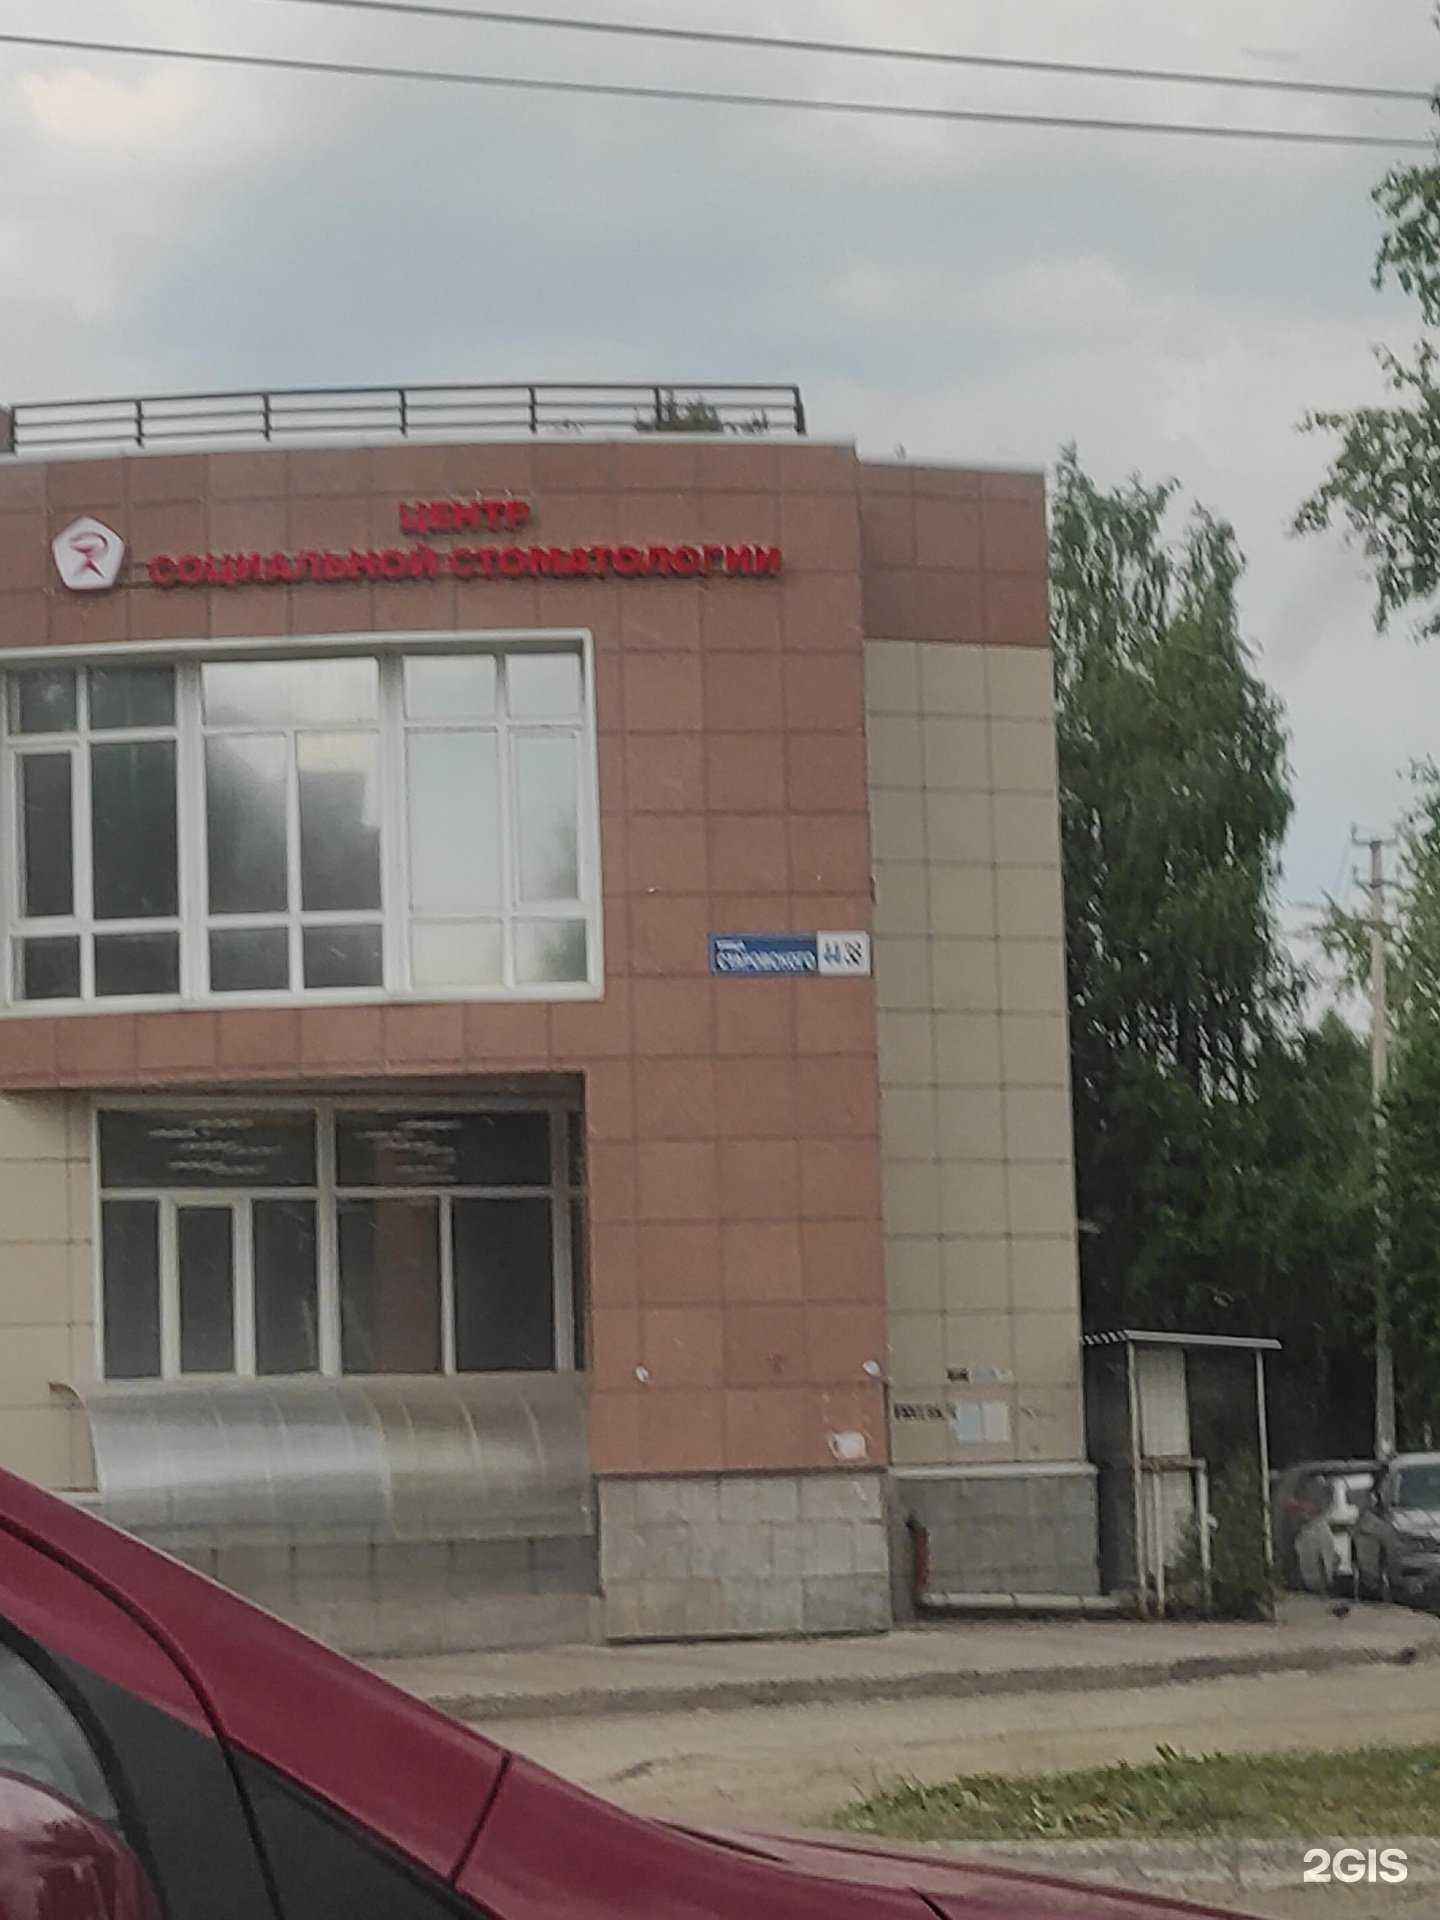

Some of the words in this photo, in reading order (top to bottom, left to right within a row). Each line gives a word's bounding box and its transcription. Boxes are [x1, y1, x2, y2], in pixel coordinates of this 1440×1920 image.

[400, 498, 531, 533] ЦЕНТР
[147, 543, 438, 589] СОЦИАЛЬНОЙ
[449, 544, 783, 580] СТОМАТОЛОГИИ
